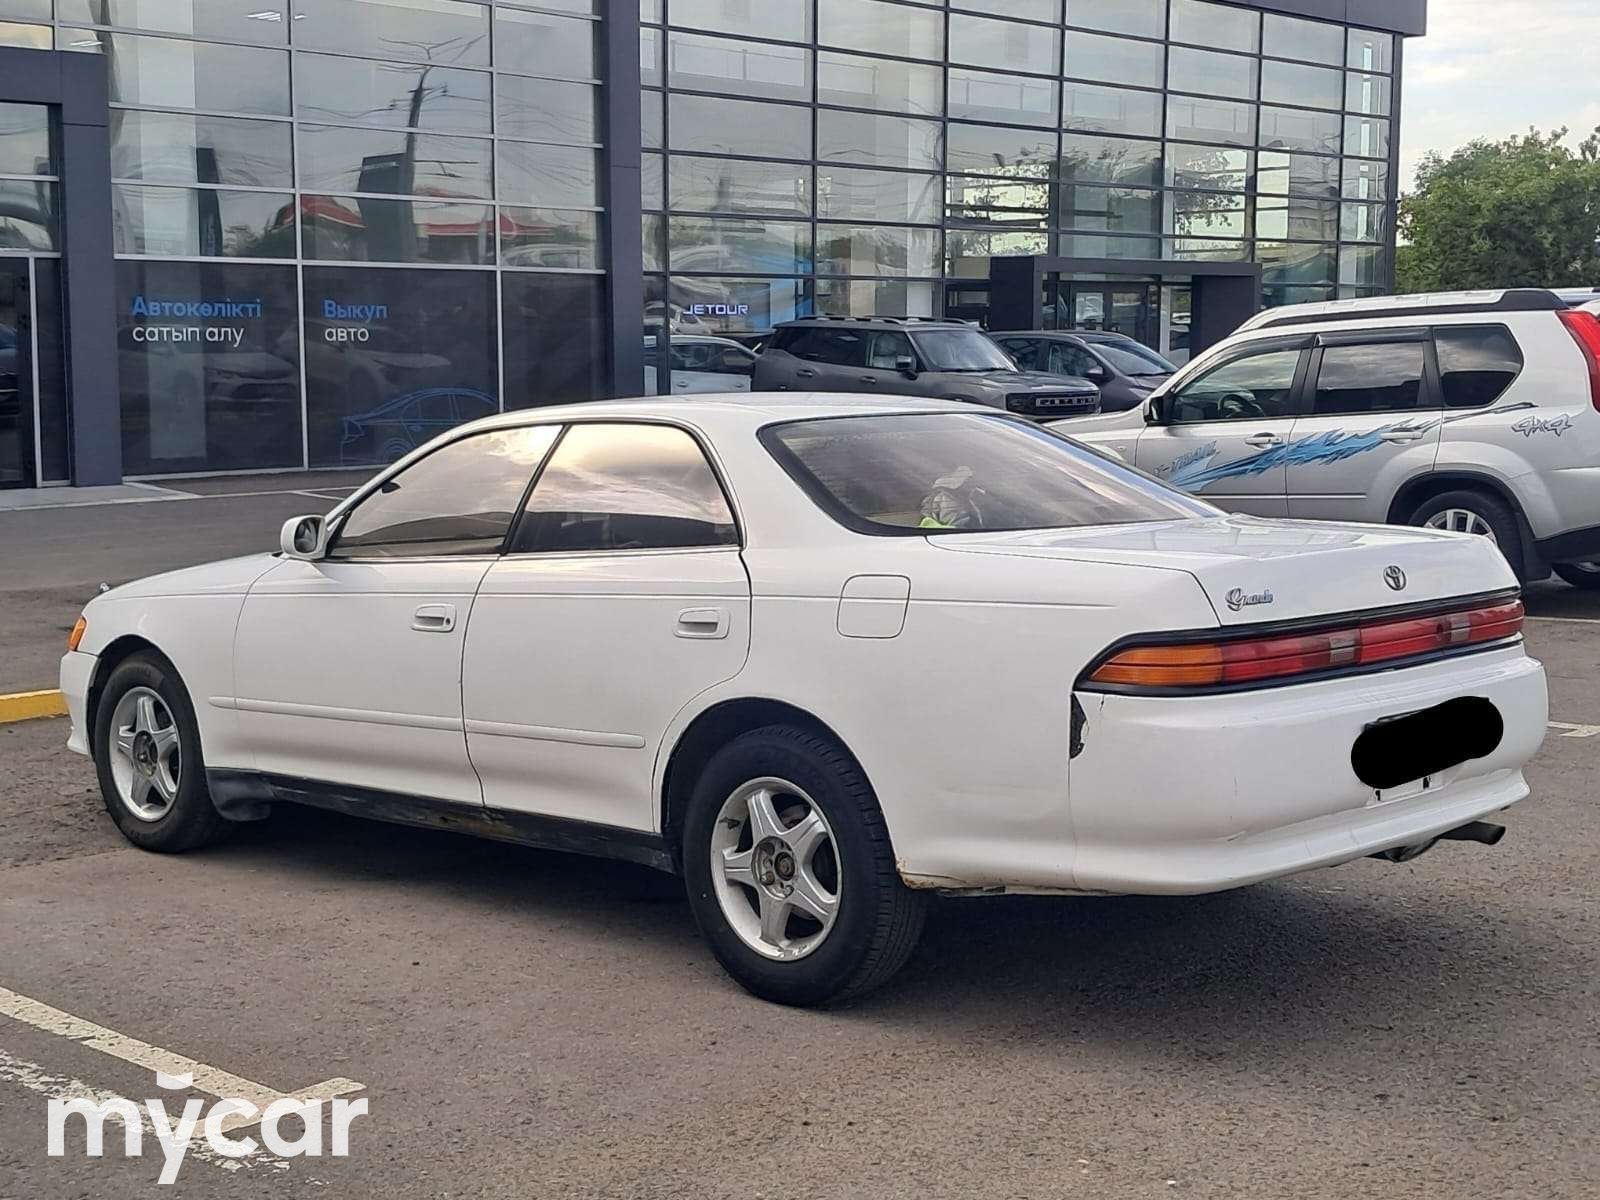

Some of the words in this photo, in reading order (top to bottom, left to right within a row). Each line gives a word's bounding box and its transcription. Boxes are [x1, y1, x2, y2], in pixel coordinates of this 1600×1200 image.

[132, 296, 262, 318] Автокөлікті
[324, 299, 388, 322] Выкуп
[683, 304, 749, 315] JETOUR
[132, 326, 200, 343] сатып
[205, 326, 244, 347] алу
[324, 327, 370, 343] авто
